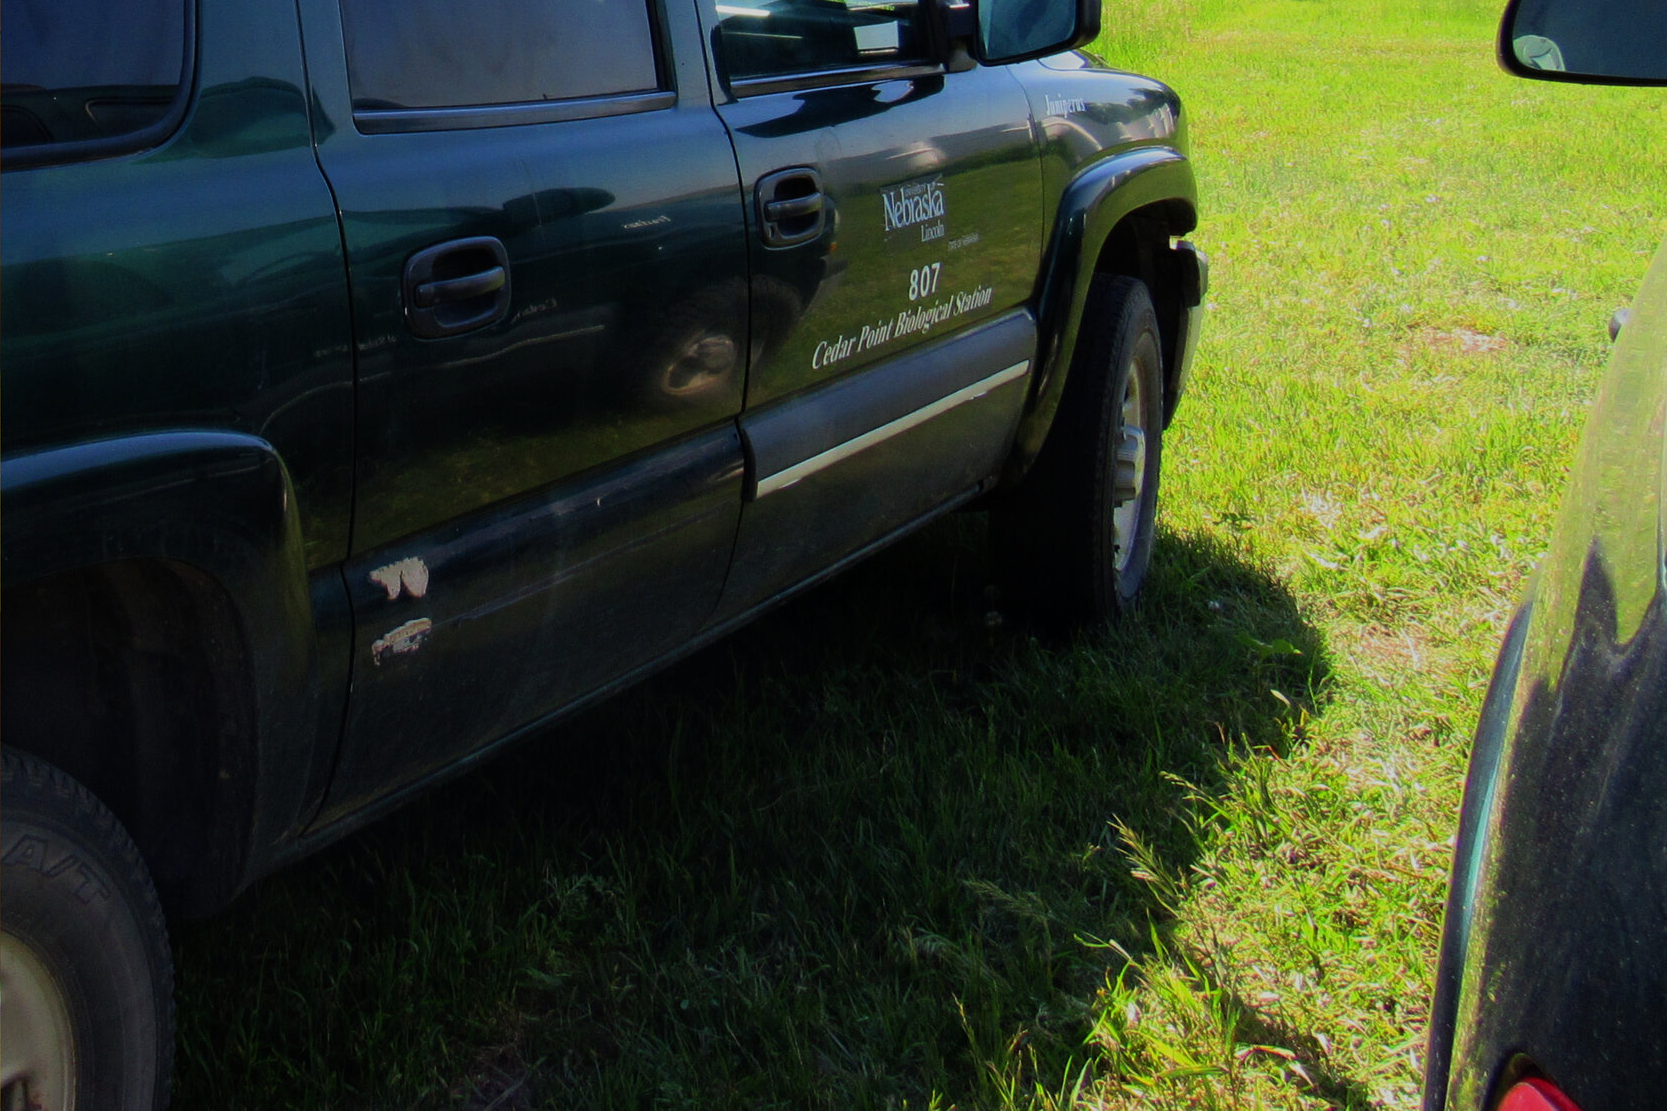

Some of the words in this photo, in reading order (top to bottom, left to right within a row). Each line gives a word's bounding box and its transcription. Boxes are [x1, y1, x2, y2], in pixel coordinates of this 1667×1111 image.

[882, 183, 945, 231] Nebraska
[908, 262, 941, 301] 807
[811, 335, 857, 370] Cedar
[856, 317, 894, 353] Point
[893, 295, 955, 334] Biological
[953, 284, 993, 317] Station
